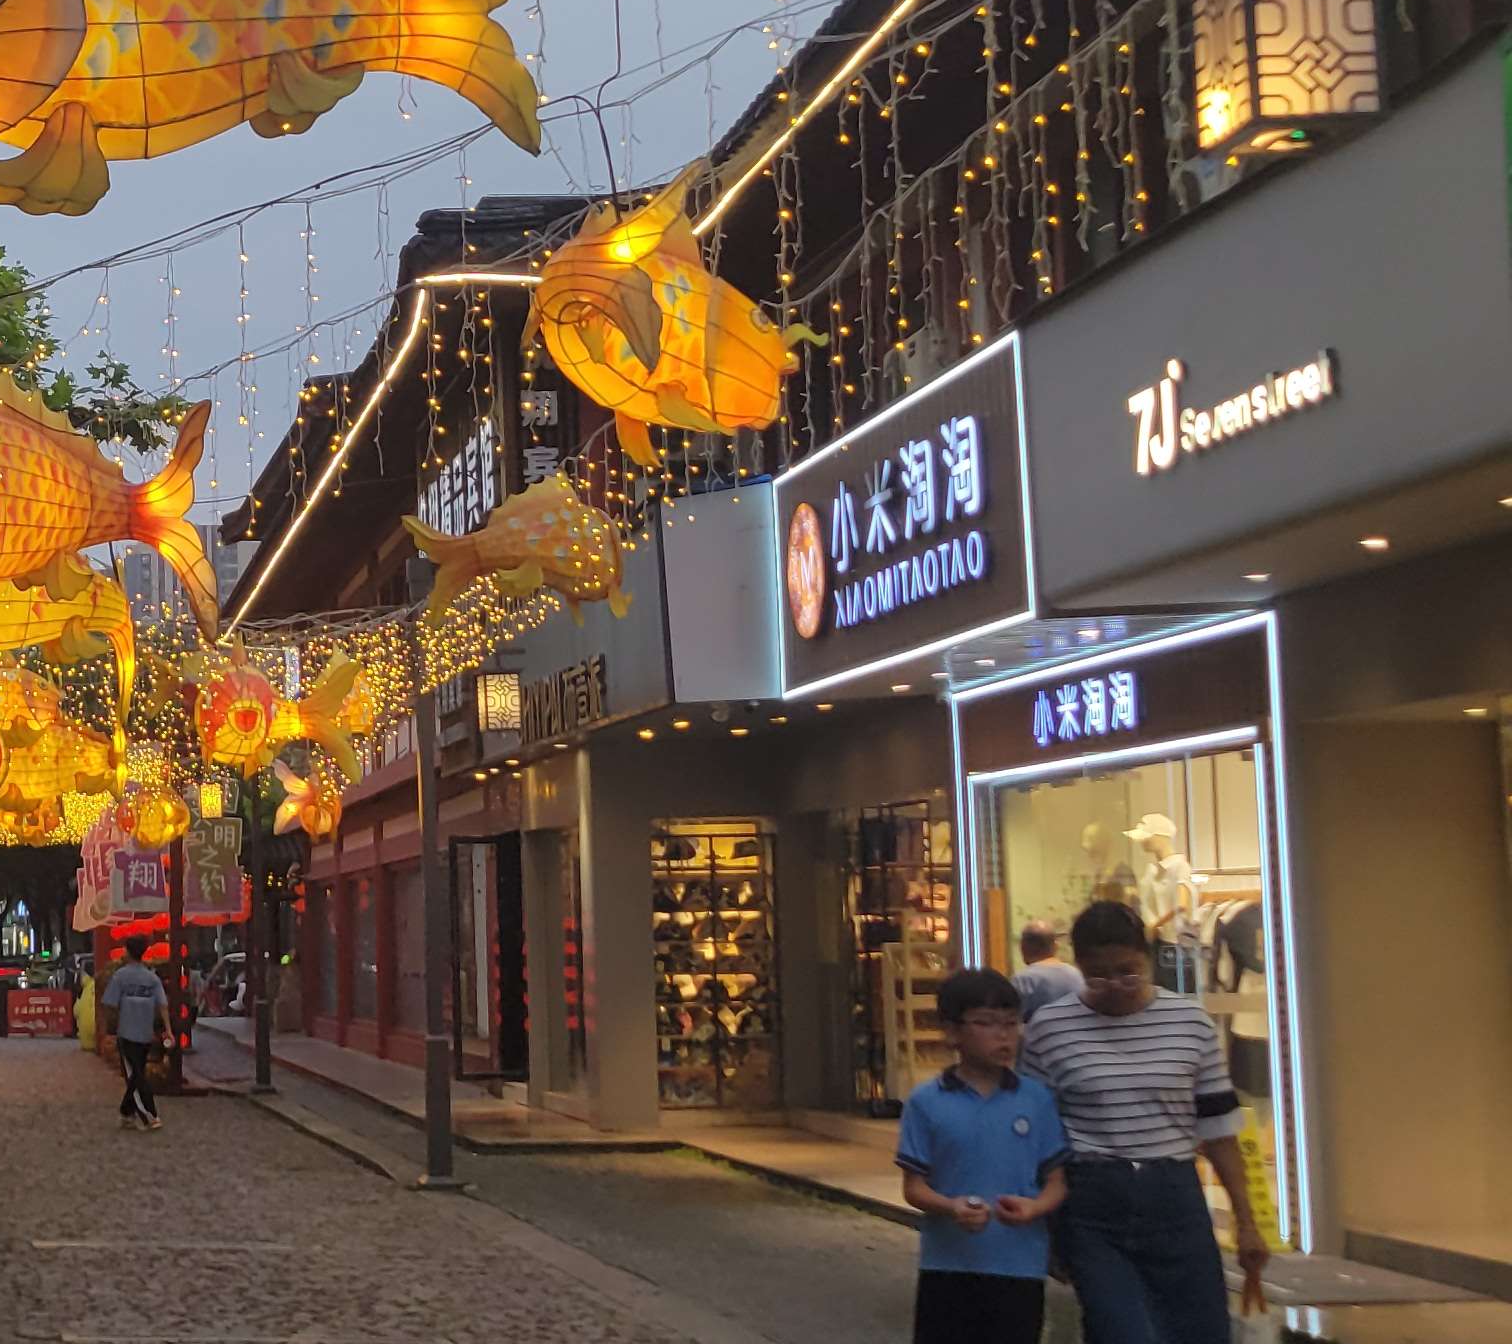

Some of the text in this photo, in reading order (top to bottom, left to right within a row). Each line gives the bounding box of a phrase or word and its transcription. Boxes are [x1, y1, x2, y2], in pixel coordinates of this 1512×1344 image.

[830, 415, 983, 574] 小米淘淘
[1032, 670, 1137, 747] 小米淘淘
[127, 858, 158, 894] 翔
